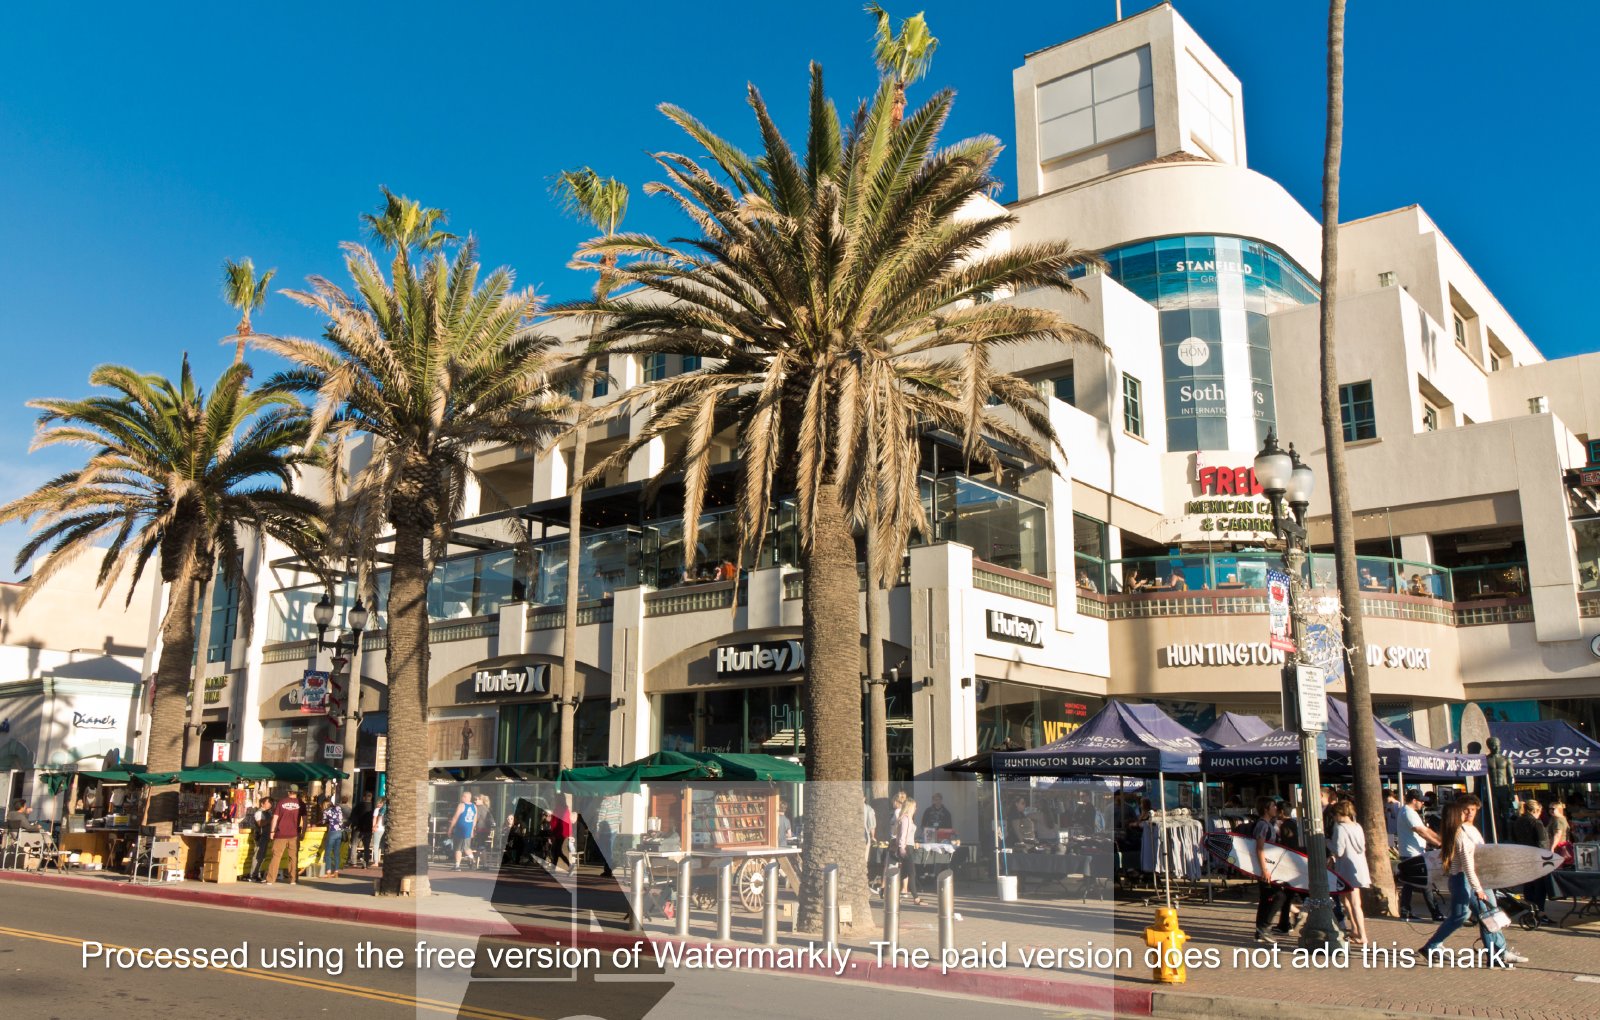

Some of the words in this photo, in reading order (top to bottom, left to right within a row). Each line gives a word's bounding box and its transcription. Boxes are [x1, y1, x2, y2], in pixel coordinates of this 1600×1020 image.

[1176, 261, 1252, 275] STANFIELD
[1188, 500, 1254, 514] MEXICAN
[1219, 518, 1274, 531] CANTIN
[991, 611, 1034, 643] Hurley
[717, 644, 789, 673] Hurley
[1166, 641, 1285, 666] HUNTINGTON
[1388, 645, 1431, 670] SPORT
[475, 669, 526, 693] Hurley
[1004, 757, 1068, 768] HUNTINGTON
[1072, 757, 1096, 766] SURF
[1113, 756, 1147, 766] SPORT
[1210, 756, 1288, 767] HUNTINGTON
[1407, 755, 1445, 770] HUNTINGTON
[1547, 769, 1581, 777] SPORT
